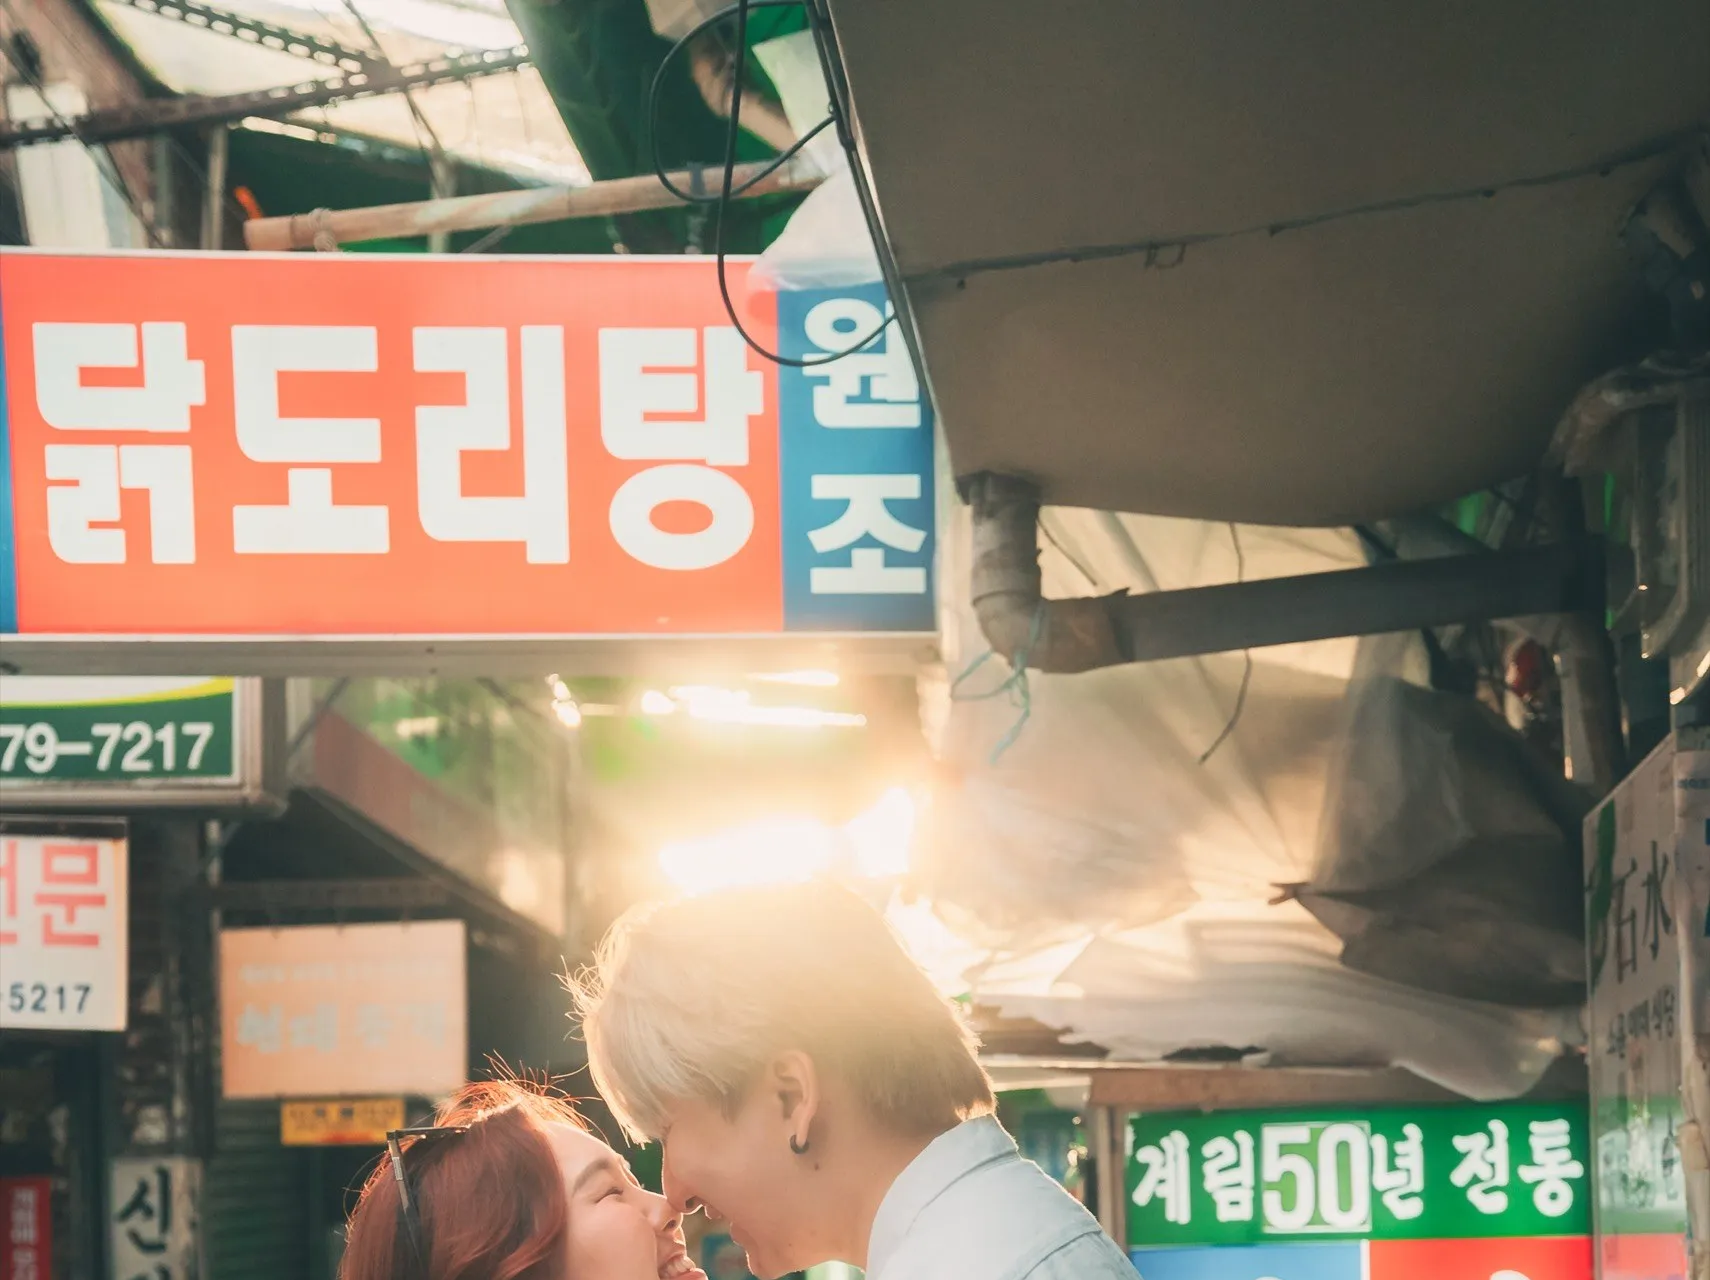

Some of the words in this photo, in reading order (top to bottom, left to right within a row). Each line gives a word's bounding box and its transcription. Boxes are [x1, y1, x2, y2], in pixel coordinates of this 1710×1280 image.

[32, 321, 764, 571] 닭도리탕
[803, 298, 928, 594] 원조
[1450, 1118, 1584, 1217] 전통
